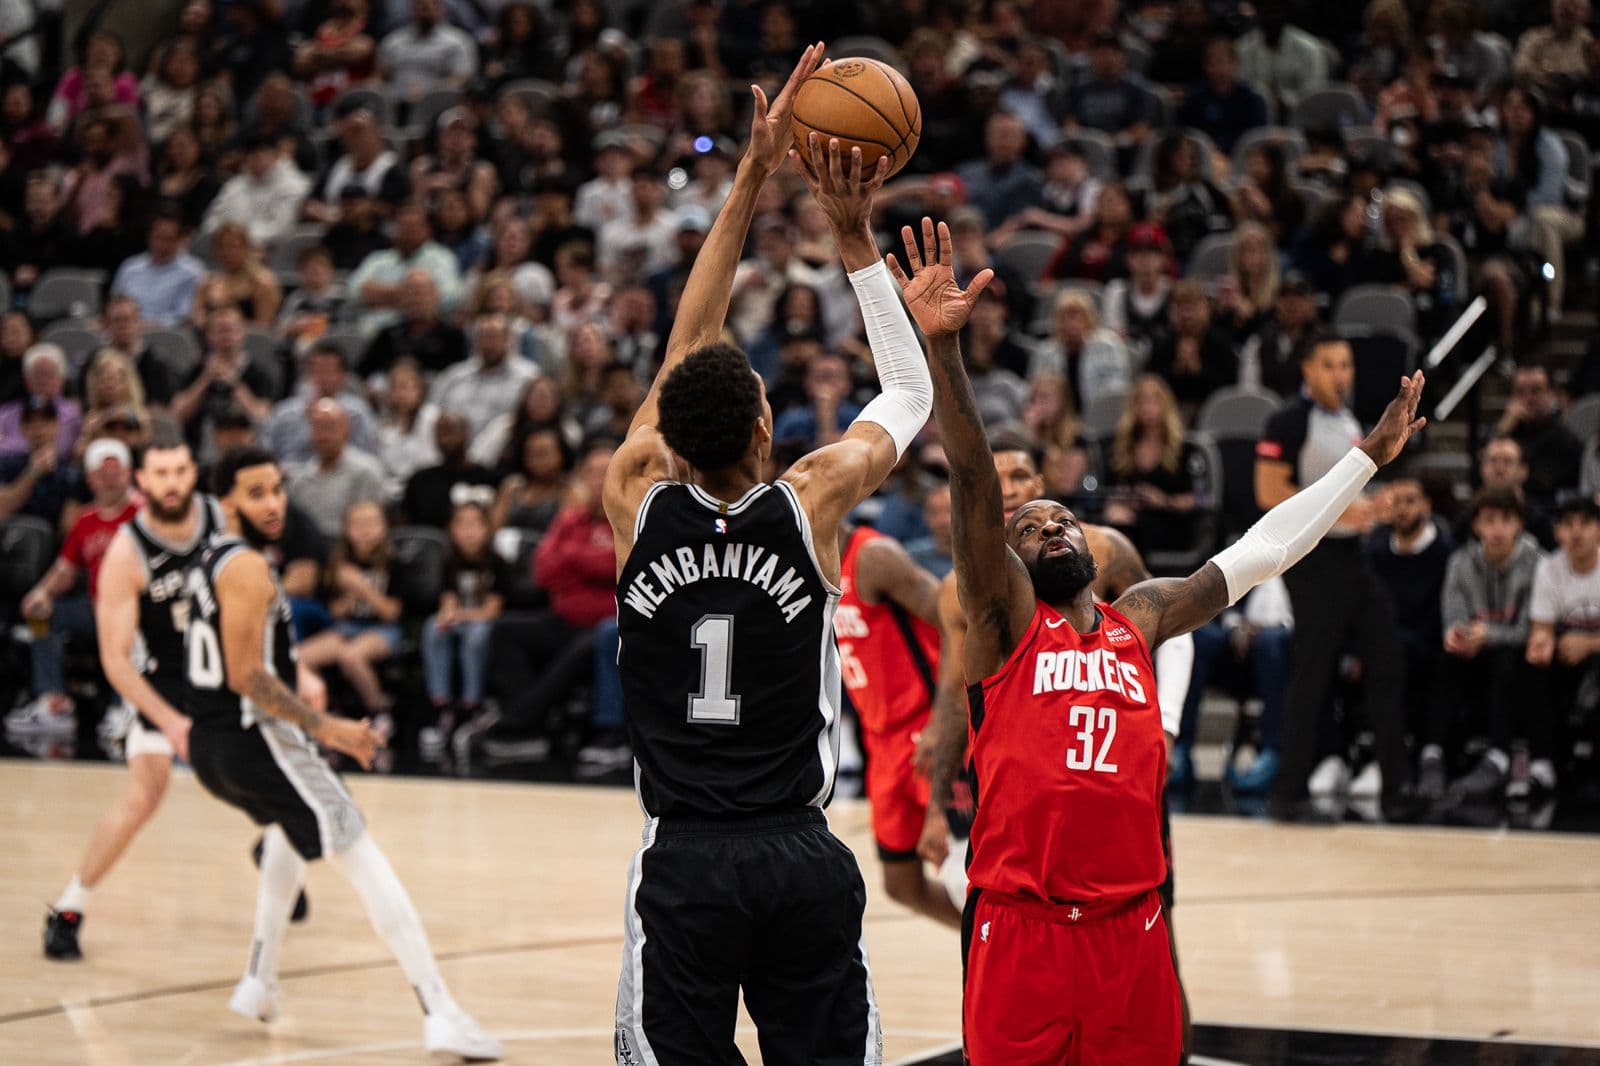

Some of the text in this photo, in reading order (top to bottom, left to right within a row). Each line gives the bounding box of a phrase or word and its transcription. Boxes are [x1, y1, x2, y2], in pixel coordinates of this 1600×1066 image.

[624, 543, 812, 624] WEMBANYAMA
[687, 614, 741, 725] 1
[1032, 648, 1147, 704] ROCKETS
[1066, 705, 1118, 773] 32
